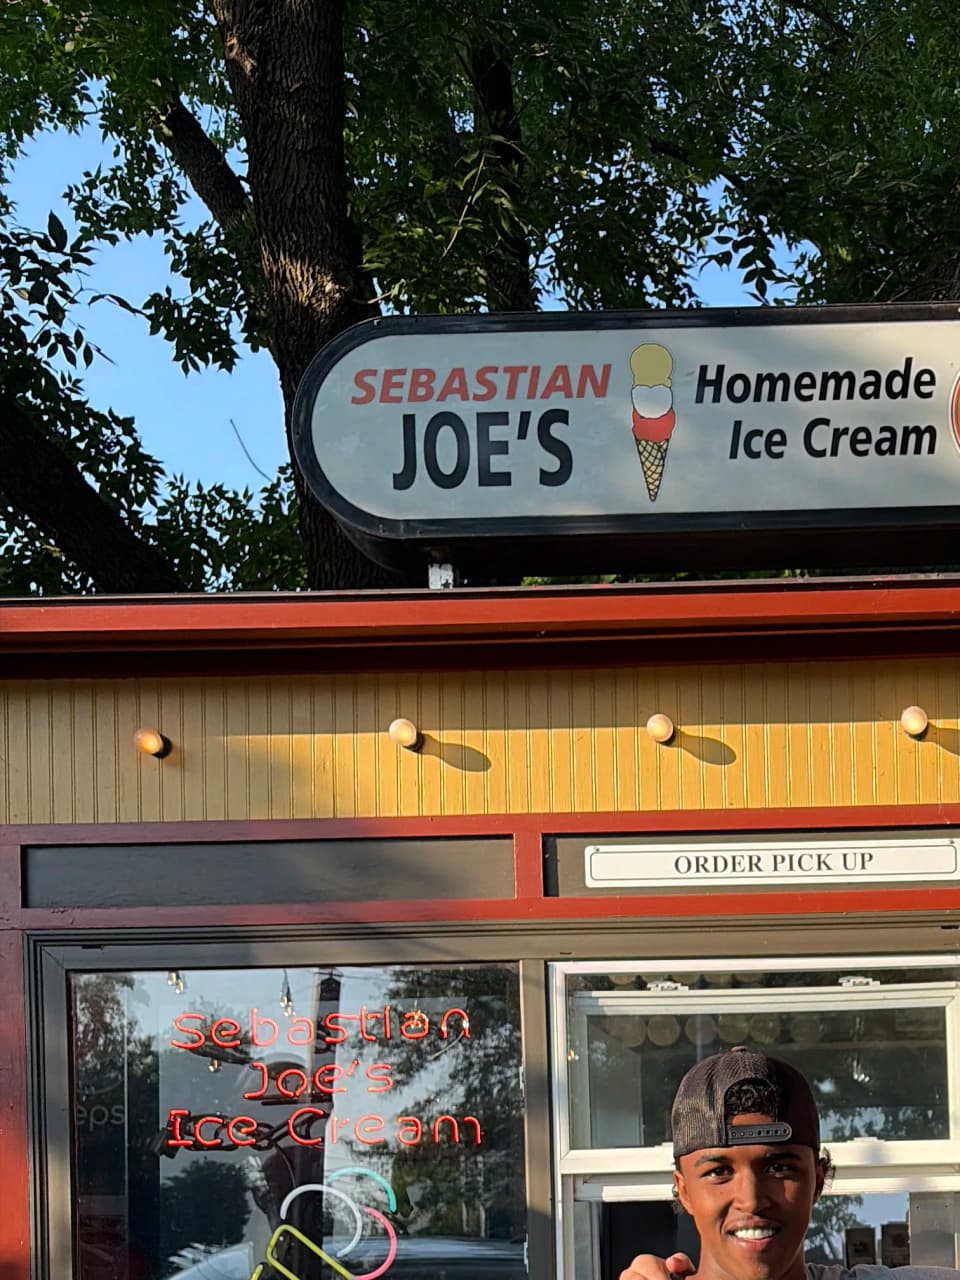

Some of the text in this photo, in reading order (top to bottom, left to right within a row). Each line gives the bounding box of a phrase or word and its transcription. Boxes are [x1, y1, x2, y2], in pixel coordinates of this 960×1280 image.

[350, 363, 610, 405] SEBASTIAN
[694, 357, 936, 404] Homemade
[393, 408, 573, 491] JOE'S
[729, 419, 936, 460] Ice Cream
[674, 852, 874, 874] ORDER PICK UP
[170, 1006, 471, 1050] Sebastian
[243, 1060, 393, 1099] Joe's
[167, 1107, 482, 1147] Ice Cream
